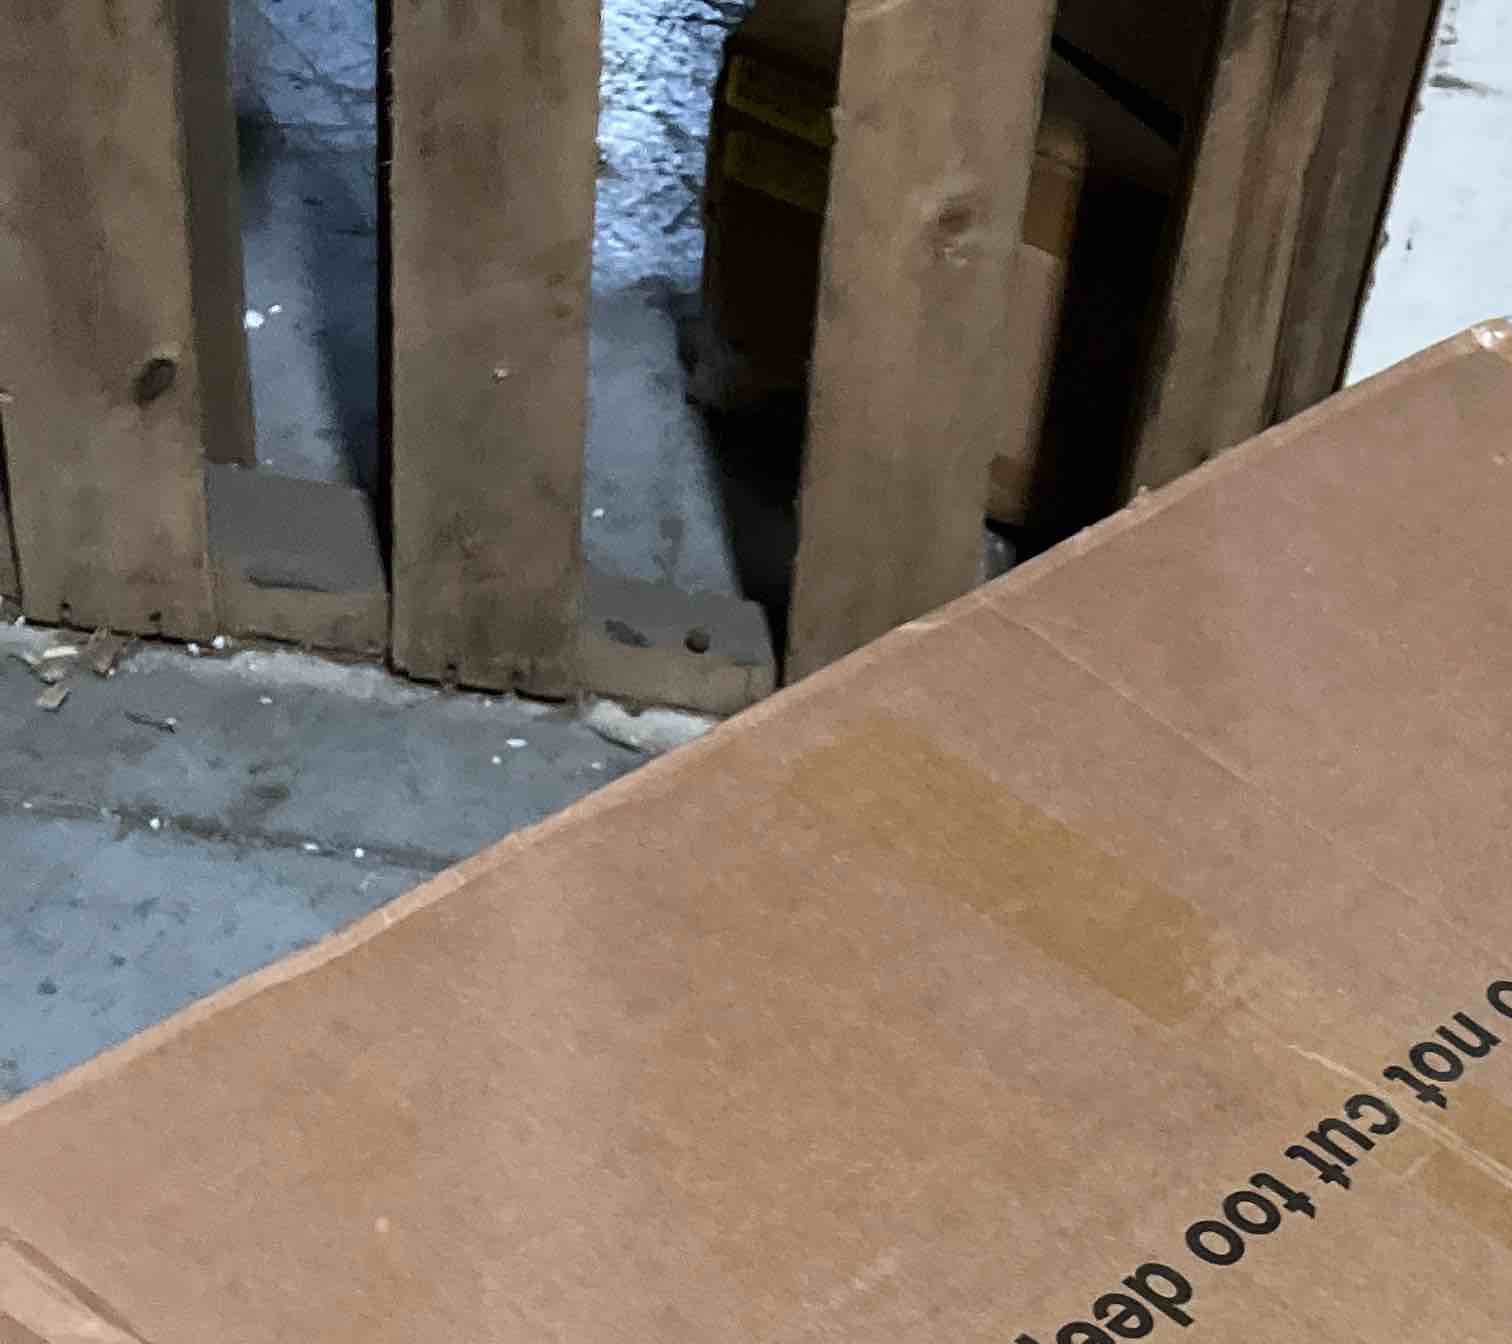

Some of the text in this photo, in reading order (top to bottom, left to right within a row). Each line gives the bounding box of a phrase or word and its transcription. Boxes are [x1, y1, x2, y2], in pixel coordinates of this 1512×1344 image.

[1382, 1010, 1503, 1110] not
[1283, 1091, 1402, 1192] cut
[1184, 1171, 1317, 1268] too
